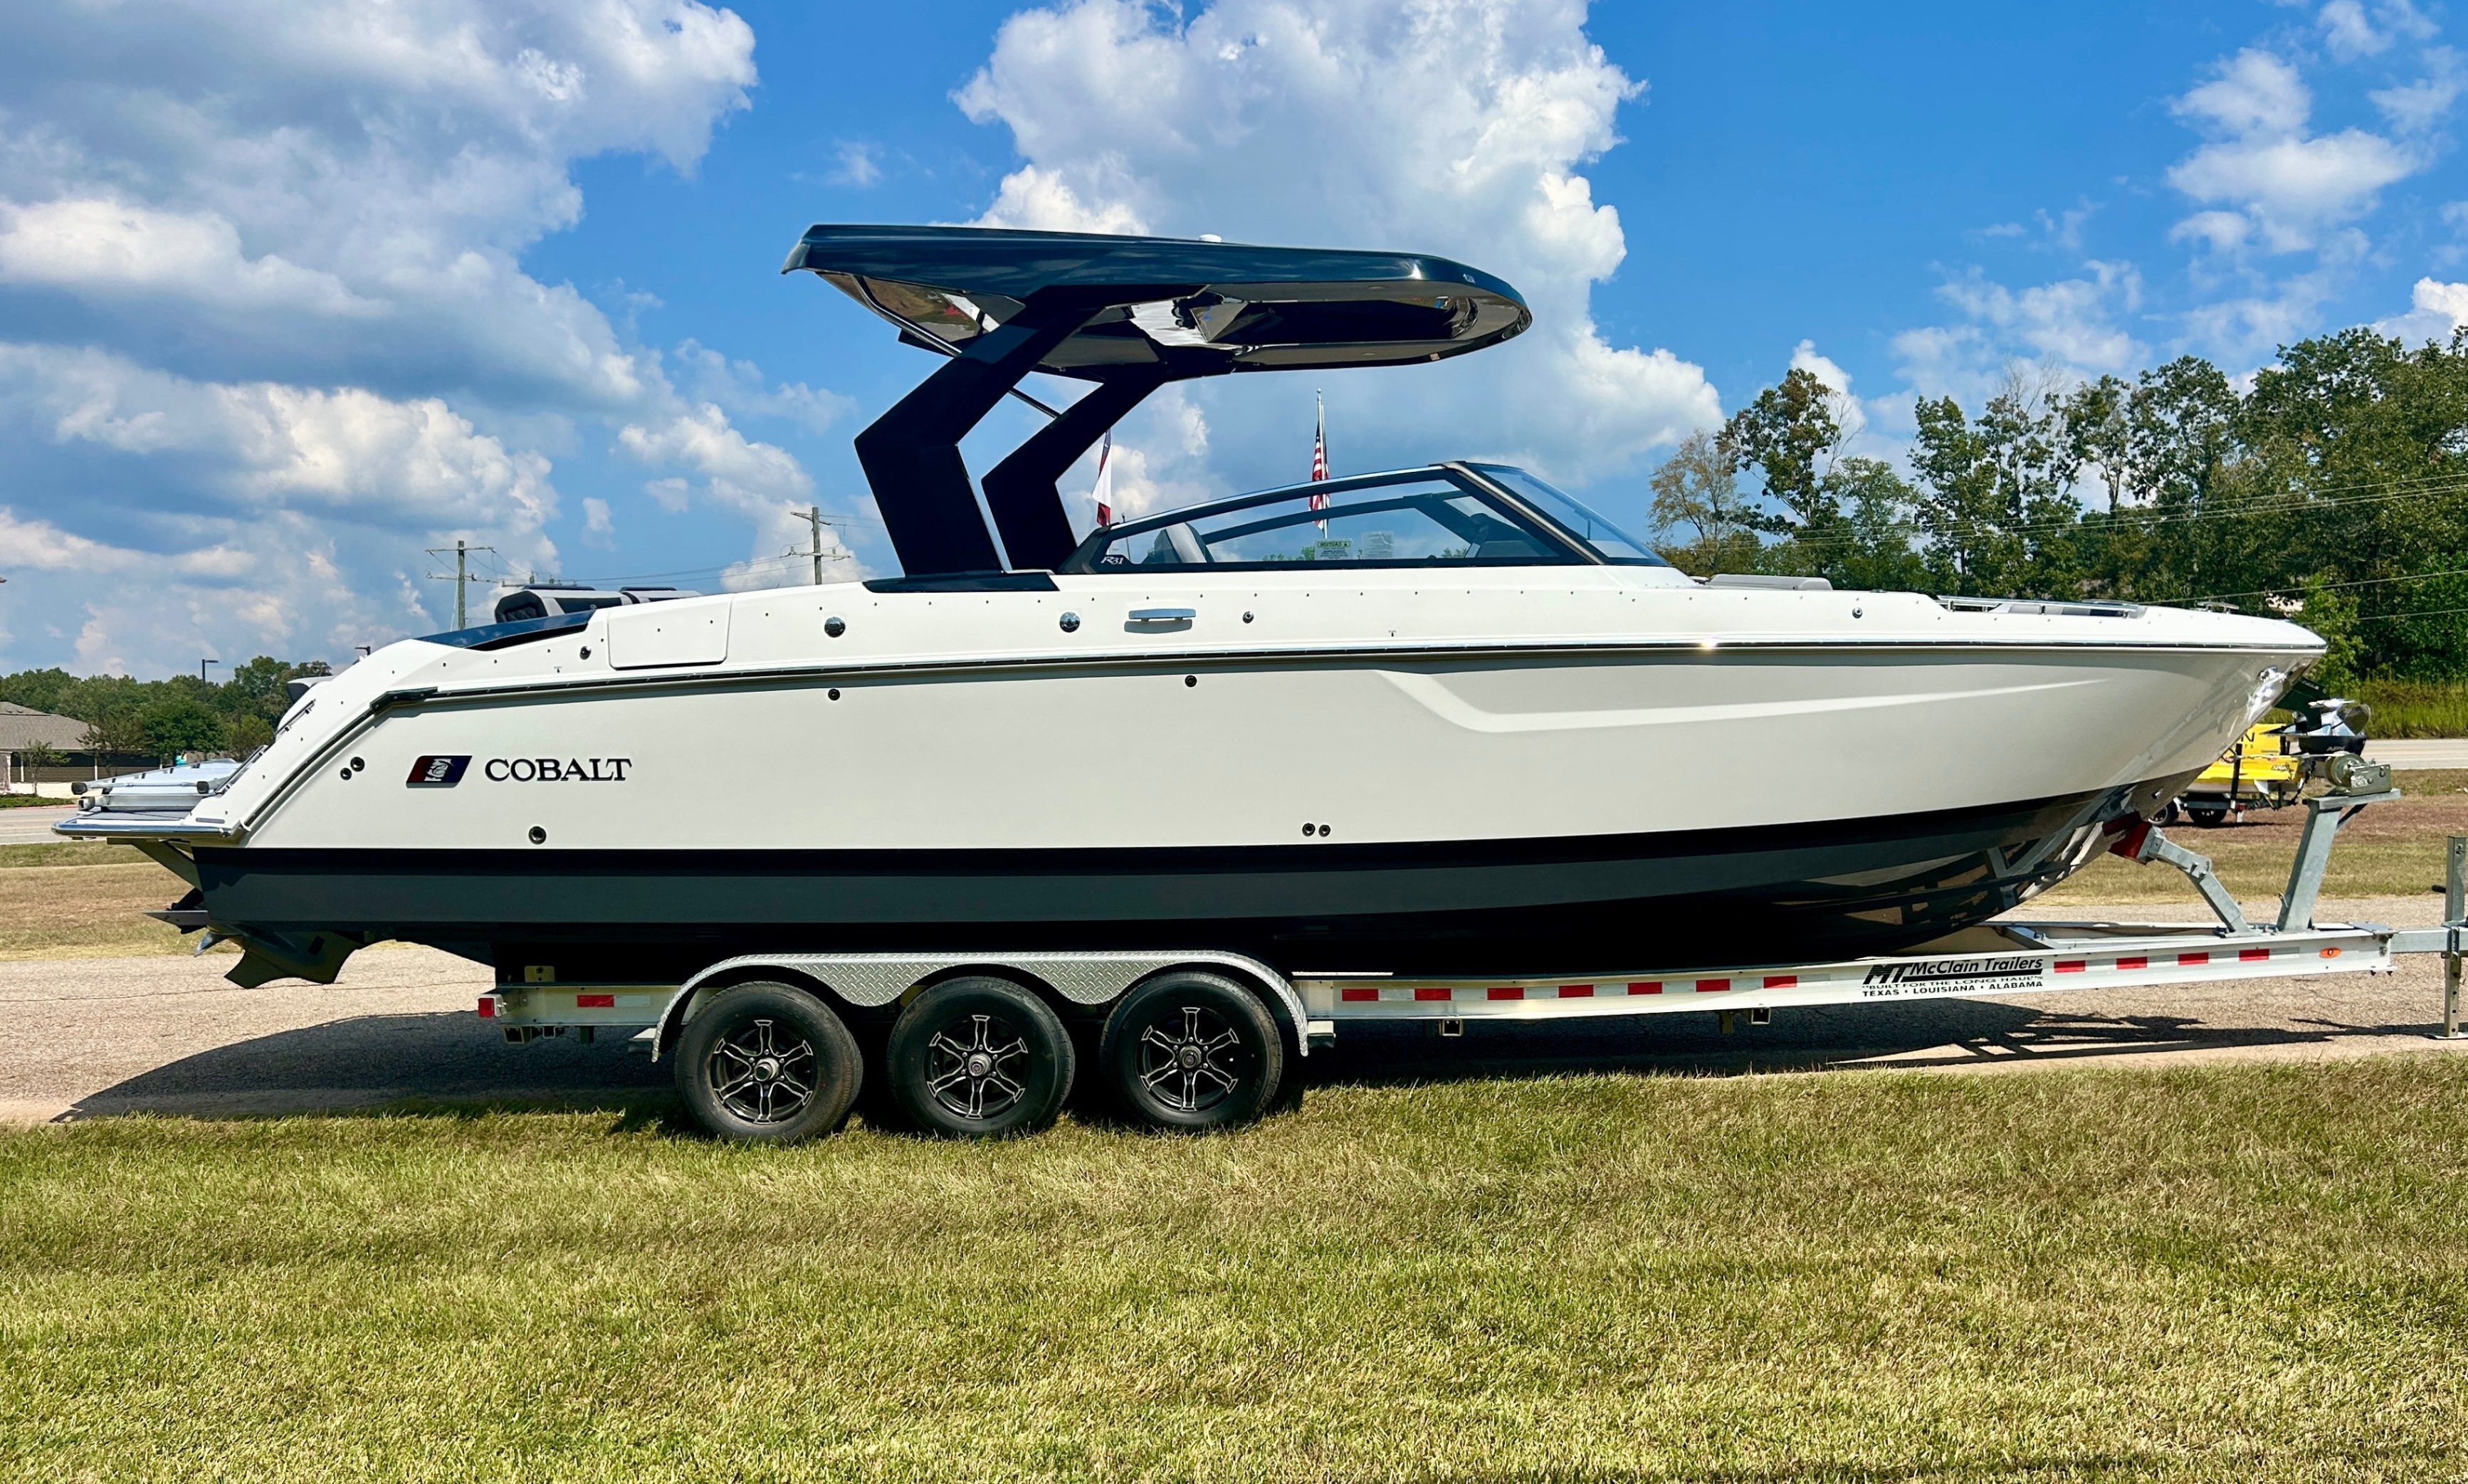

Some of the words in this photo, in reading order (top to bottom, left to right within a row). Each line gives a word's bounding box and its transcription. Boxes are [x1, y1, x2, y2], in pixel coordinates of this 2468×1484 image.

[1100, 556, 1123, 564] R31
[485, 758, 632, 782] COBALT
[1909, 959, 1979, 976] McClain
[1985, 957, 2043, 972] Trailers
[1913, 984, 1975, 994] LOUISIANA
[1989, 981, 2043, 990] ALABAMA
